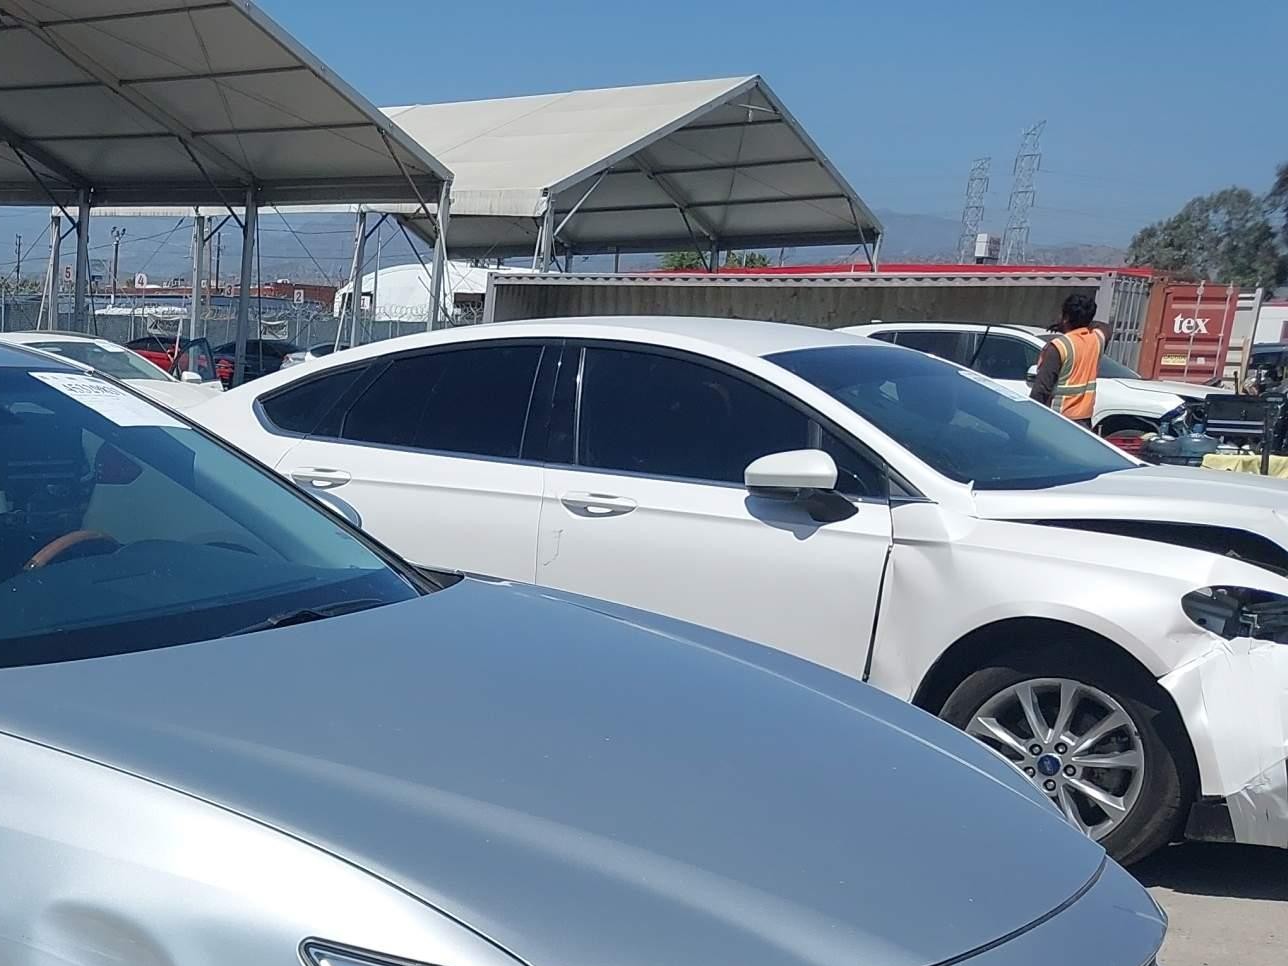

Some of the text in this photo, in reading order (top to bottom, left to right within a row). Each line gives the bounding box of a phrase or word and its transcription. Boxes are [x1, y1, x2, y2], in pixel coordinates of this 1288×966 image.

[65, 266, 71, 279] 5
[137, 274, 145, 286] 4
[295, 291, 303, 302] 2
[1173, 313, 1210, 334] tex
